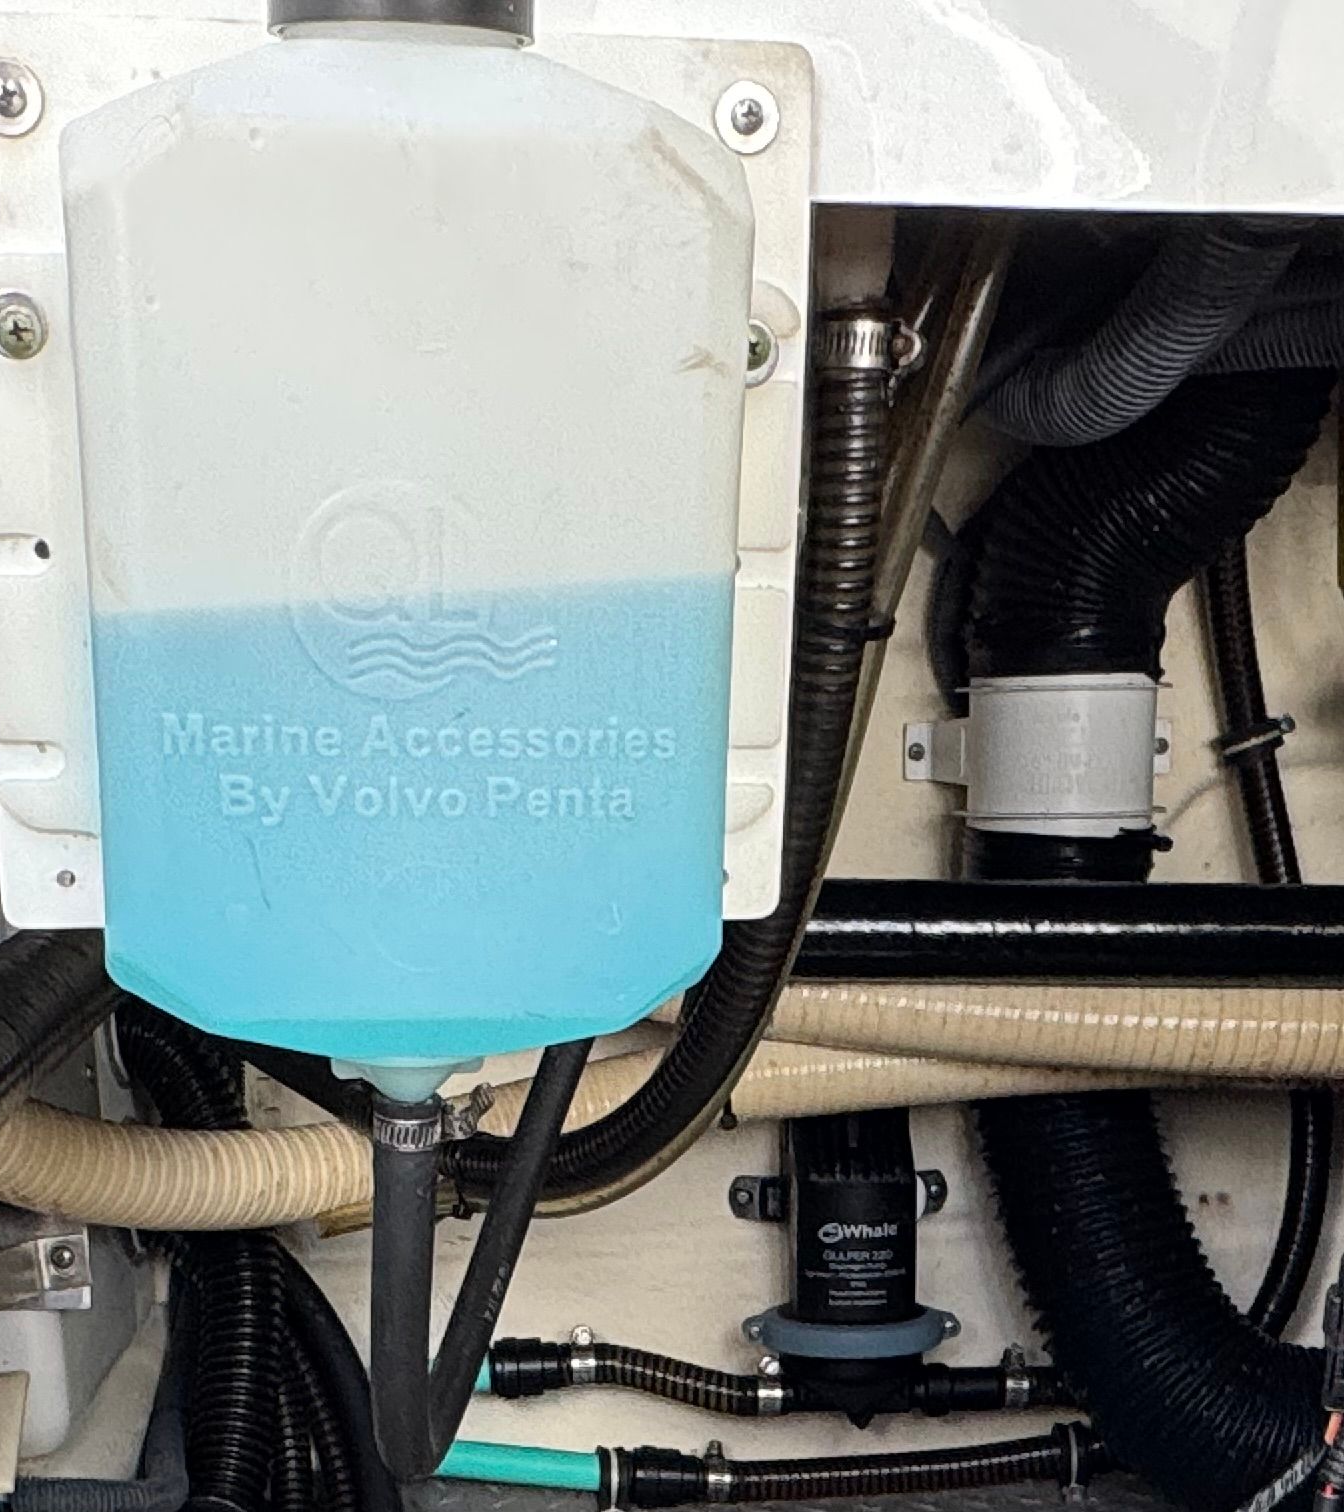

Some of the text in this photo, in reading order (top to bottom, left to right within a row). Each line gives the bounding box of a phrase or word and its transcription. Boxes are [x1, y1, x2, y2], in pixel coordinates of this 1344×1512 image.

[161, 711, 677, 761] Marine Accessories
[220, 774, 637, 826] By Volvo Penta
[842, 1222, 898, 1239] Whale
